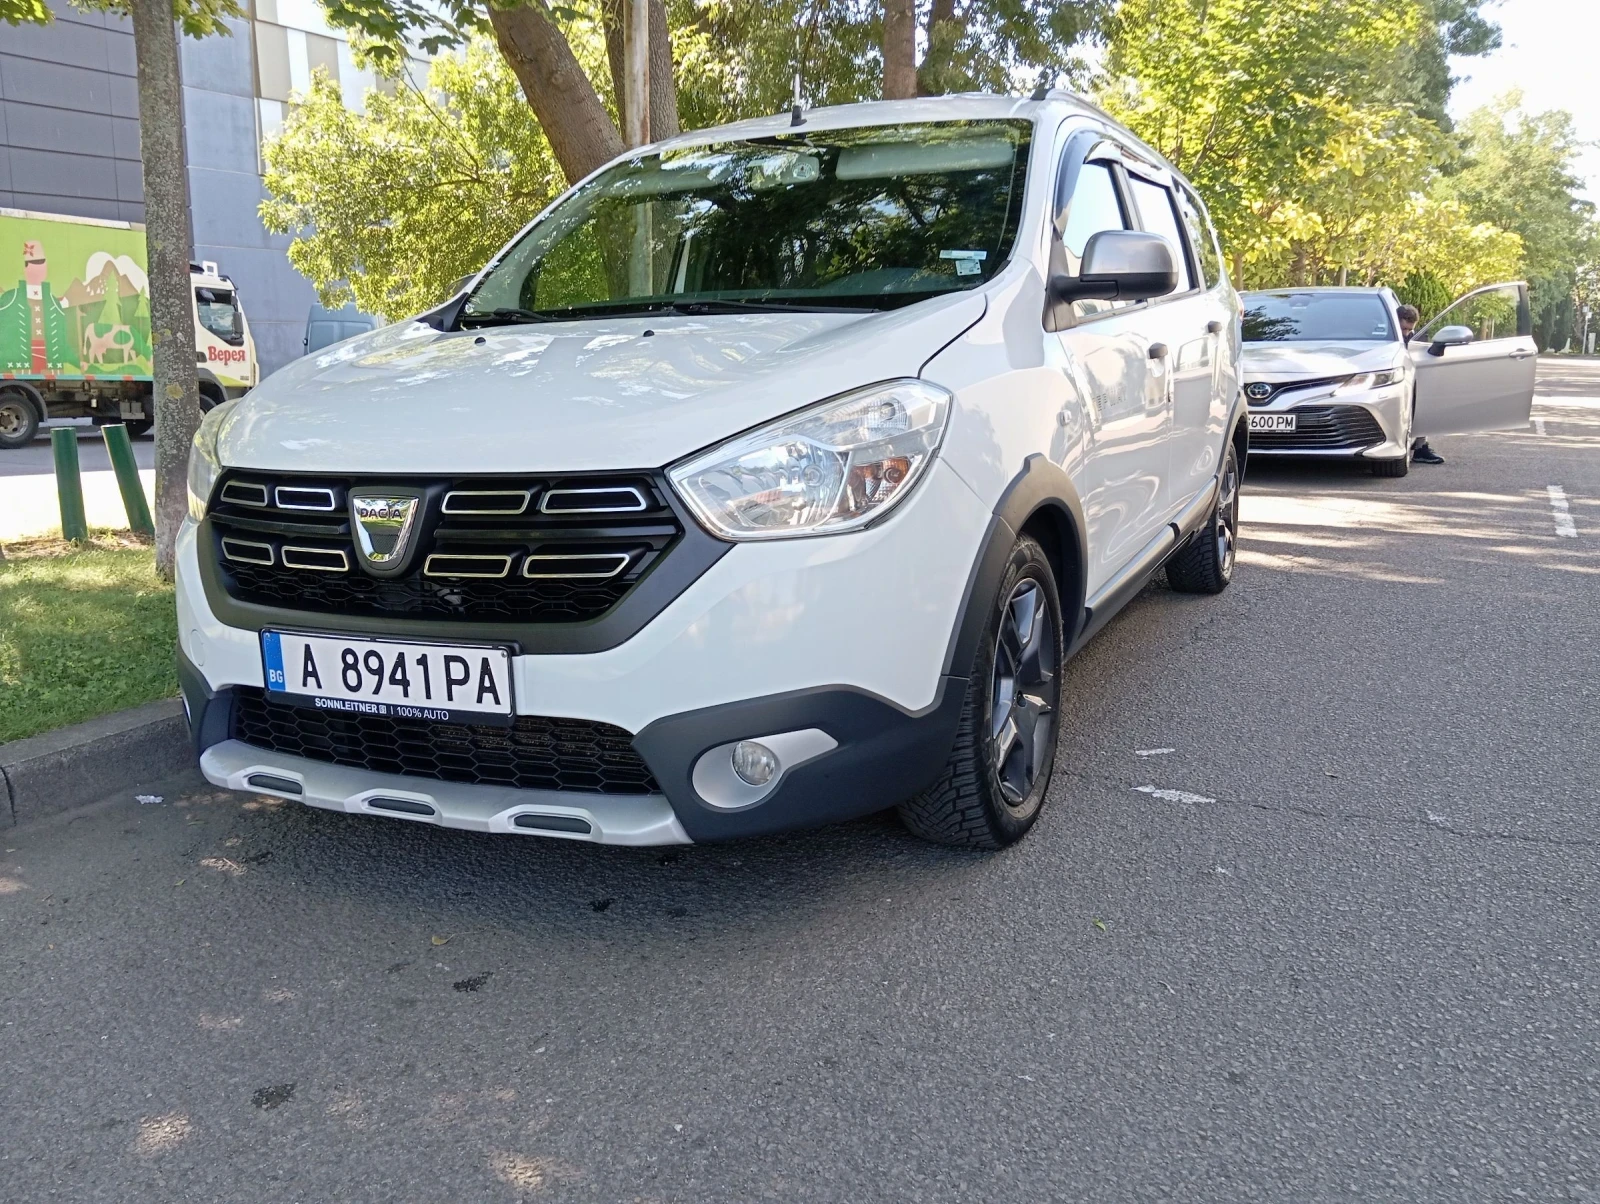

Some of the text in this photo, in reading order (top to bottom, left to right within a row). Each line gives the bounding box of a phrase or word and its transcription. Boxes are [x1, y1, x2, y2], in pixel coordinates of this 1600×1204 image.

[207, 346, 246, 366] Верея
[1248, 416, 1274, 428] 600
[360, 508, 403, 519] DACIA
[302, 643, 323, 689] A
[269, 669, 284, 684] BG
[315, 697, 378, 714] SONNLEITNER
[396, 706, 422, 718] 100%
[423, 708, 450, 720] AUTO
